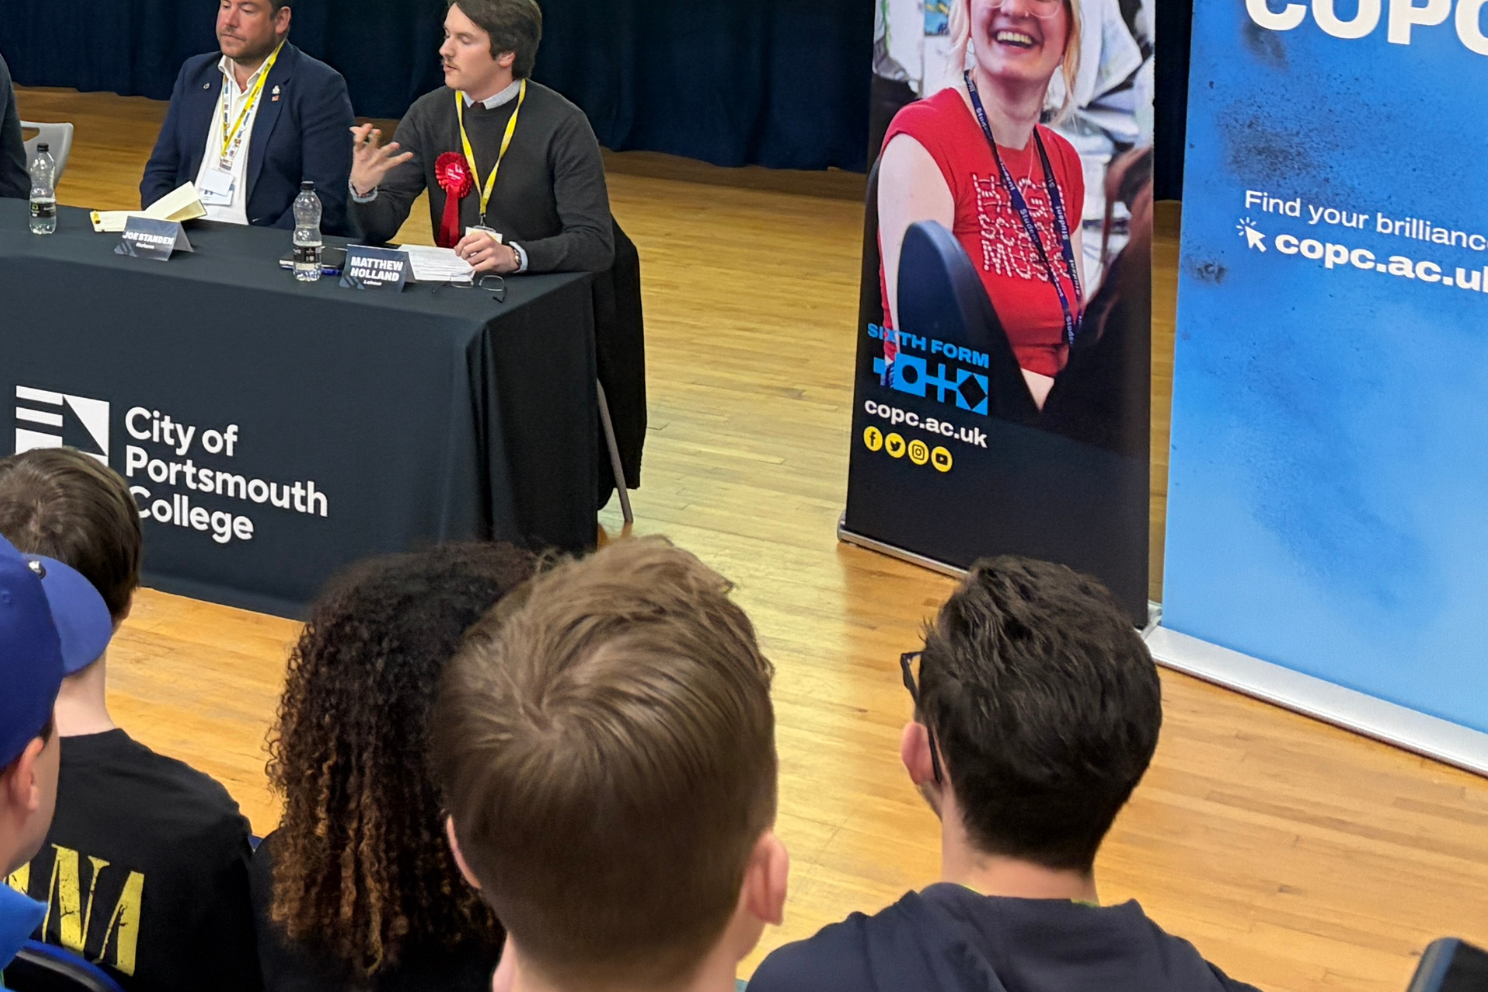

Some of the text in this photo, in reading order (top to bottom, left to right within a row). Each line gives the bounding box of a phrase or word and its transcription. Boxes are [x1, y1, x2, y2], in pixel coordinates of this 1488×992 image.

[122, 231, 175, 245] JOE STANDEN
[1245, 190, 1488, 251] Find your brillianc
[350, 267, 400, 282] HOLLAND
[351, 256, 404, 272] MATTHEW
[867, 322, 989, 369] SIXTH FORM
[125, 406, 239, 457] City of
[864, 400, 988, 448] copc.ac.uk
[125, 444, 328, 517] Portsmouth
[128, 485, 254, 544] College
